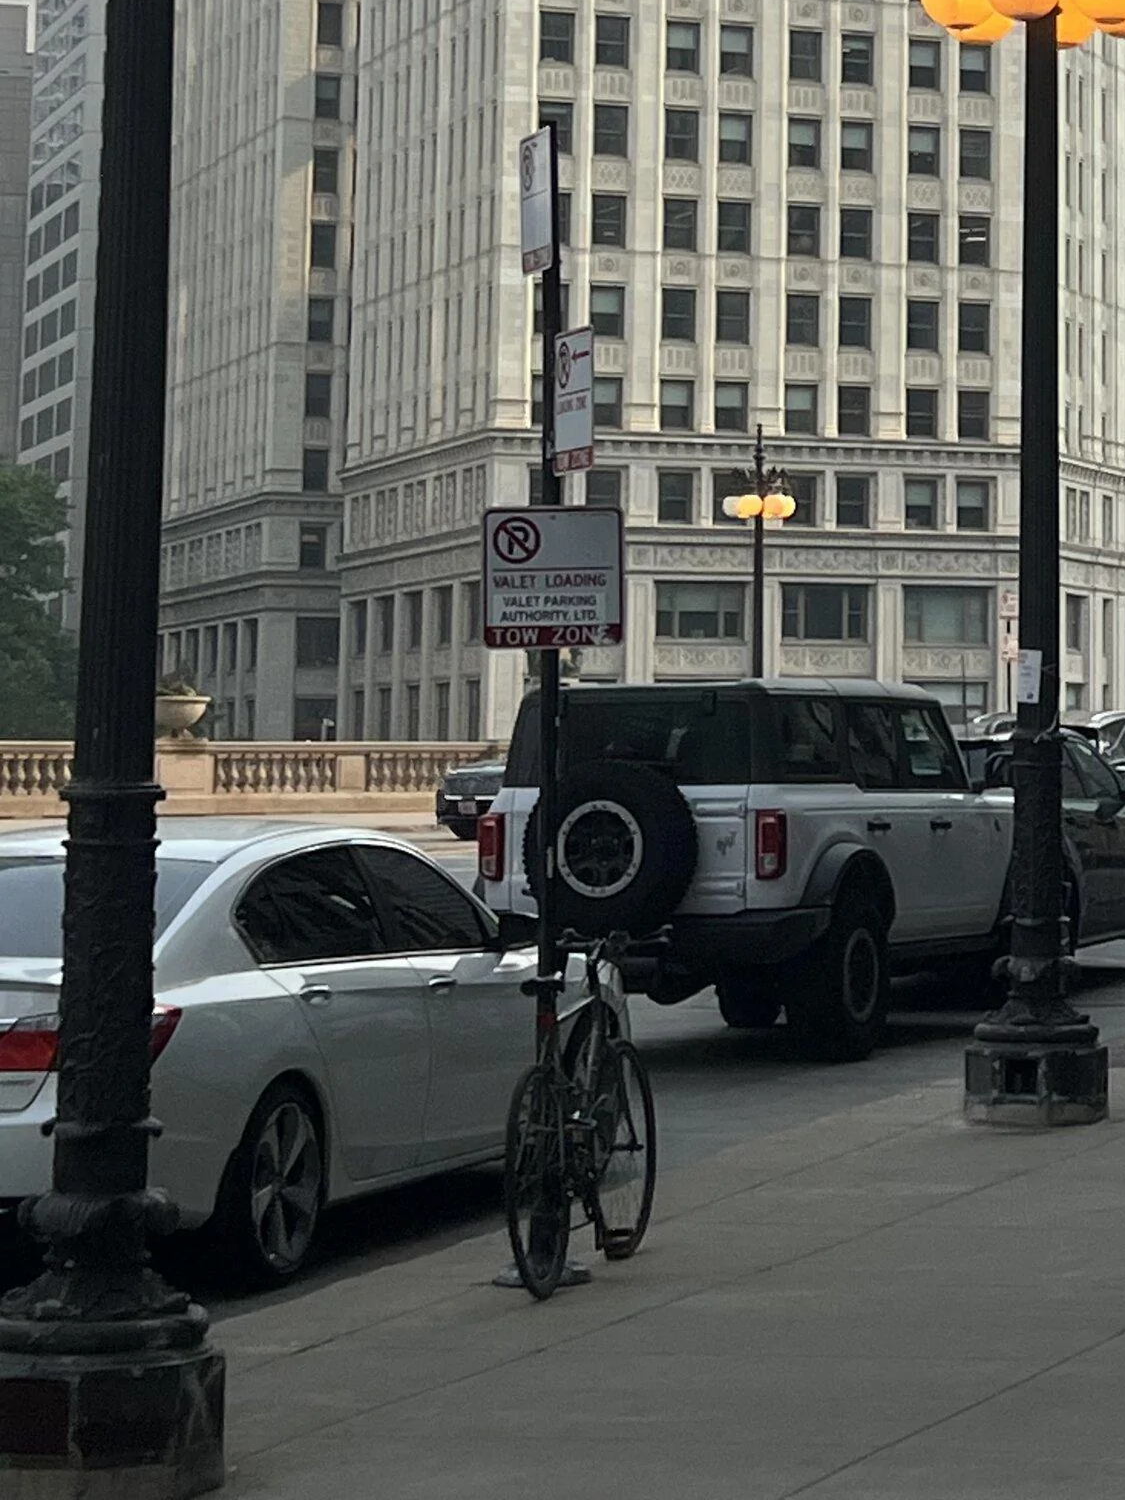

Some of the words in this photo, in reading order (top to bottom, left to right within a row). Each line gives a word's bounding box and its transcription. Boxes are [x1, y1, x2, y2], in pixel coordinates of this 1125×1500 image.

[492, 574, 536, 589] VALET
[544, 573, 607, 588] LOADING
[502, 595, 540, 607] VALET
[543, 594, 597, 607] PARKING
[493, 627, 539, 645] TOW
[551, 625, 610, 645] ZONE
